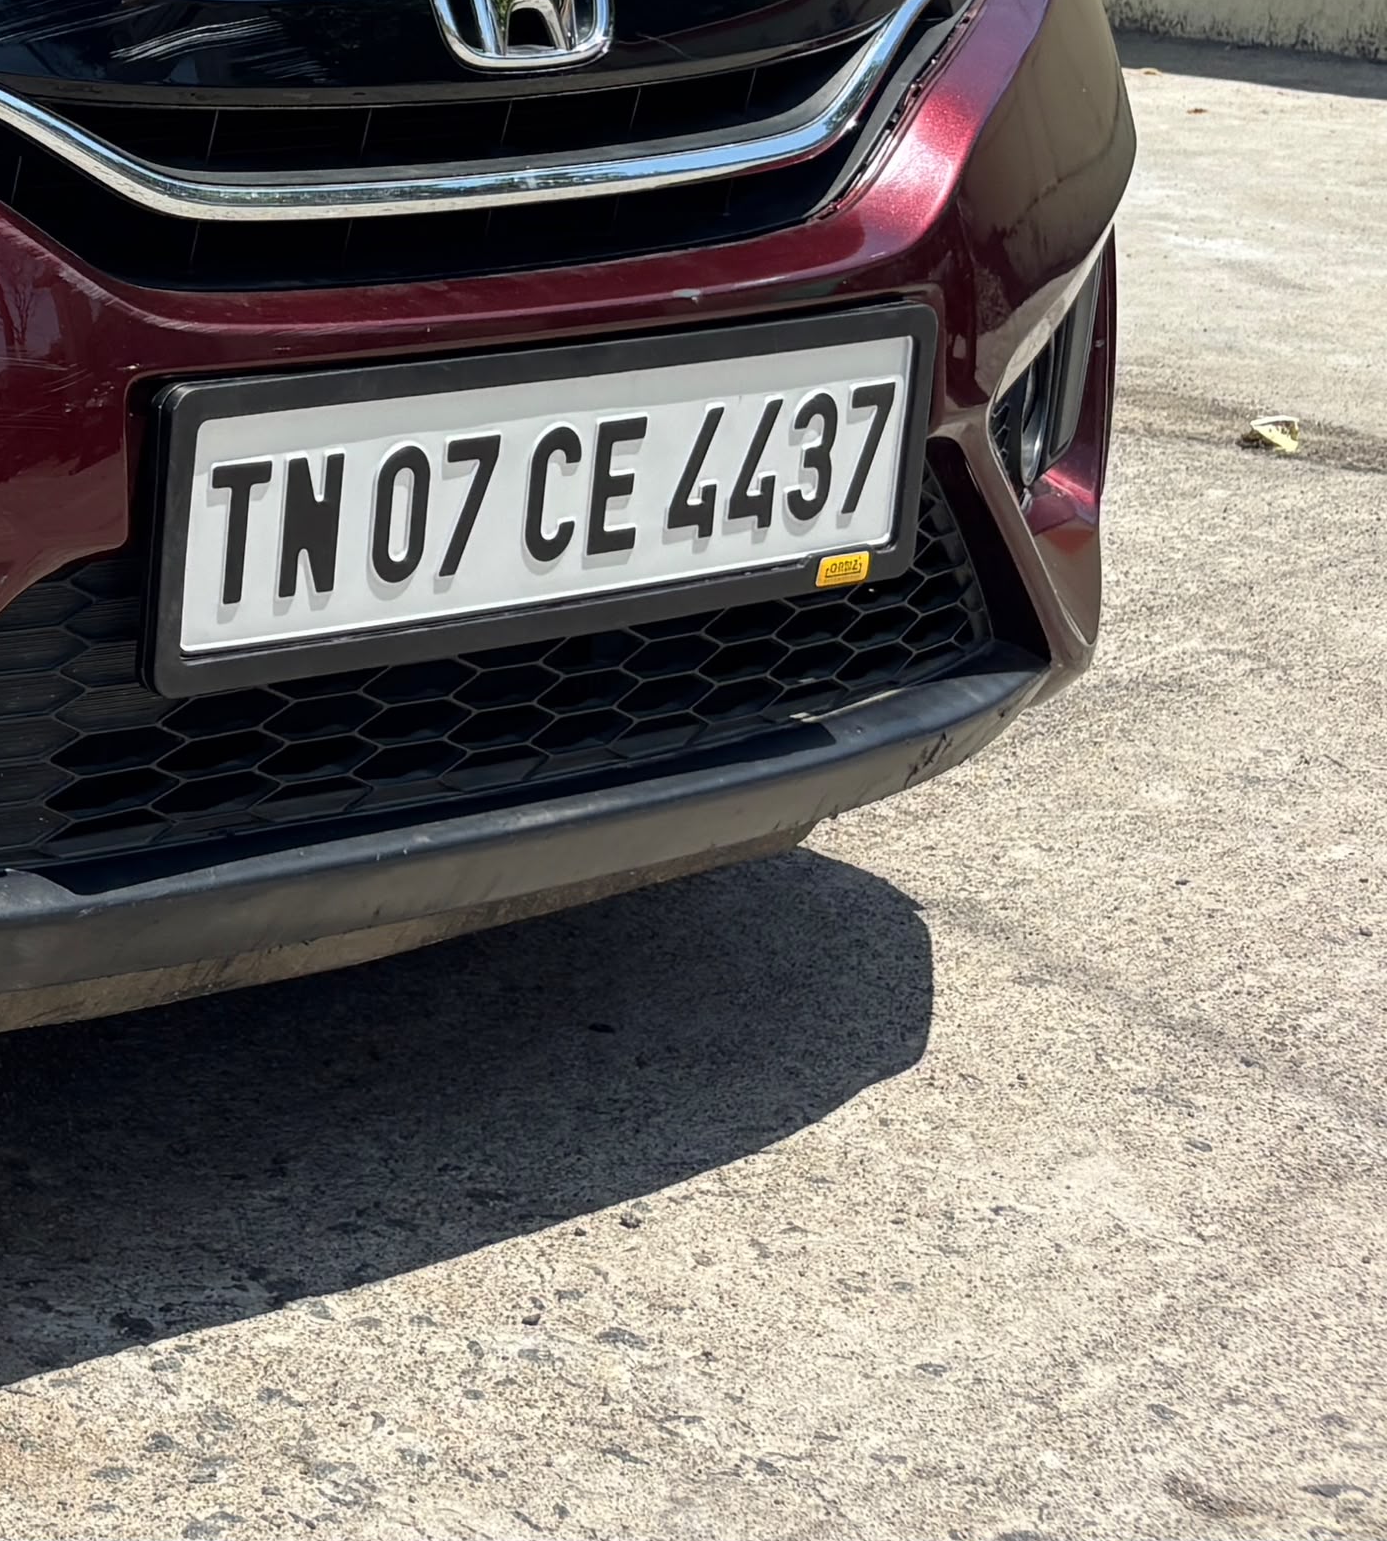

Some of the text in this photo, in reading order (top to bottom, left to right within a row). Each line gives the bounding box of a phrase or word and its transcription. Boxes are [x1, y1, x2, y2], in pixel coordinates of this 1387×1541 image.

[211, 381, 896, 605] TN 07 CE 4437
